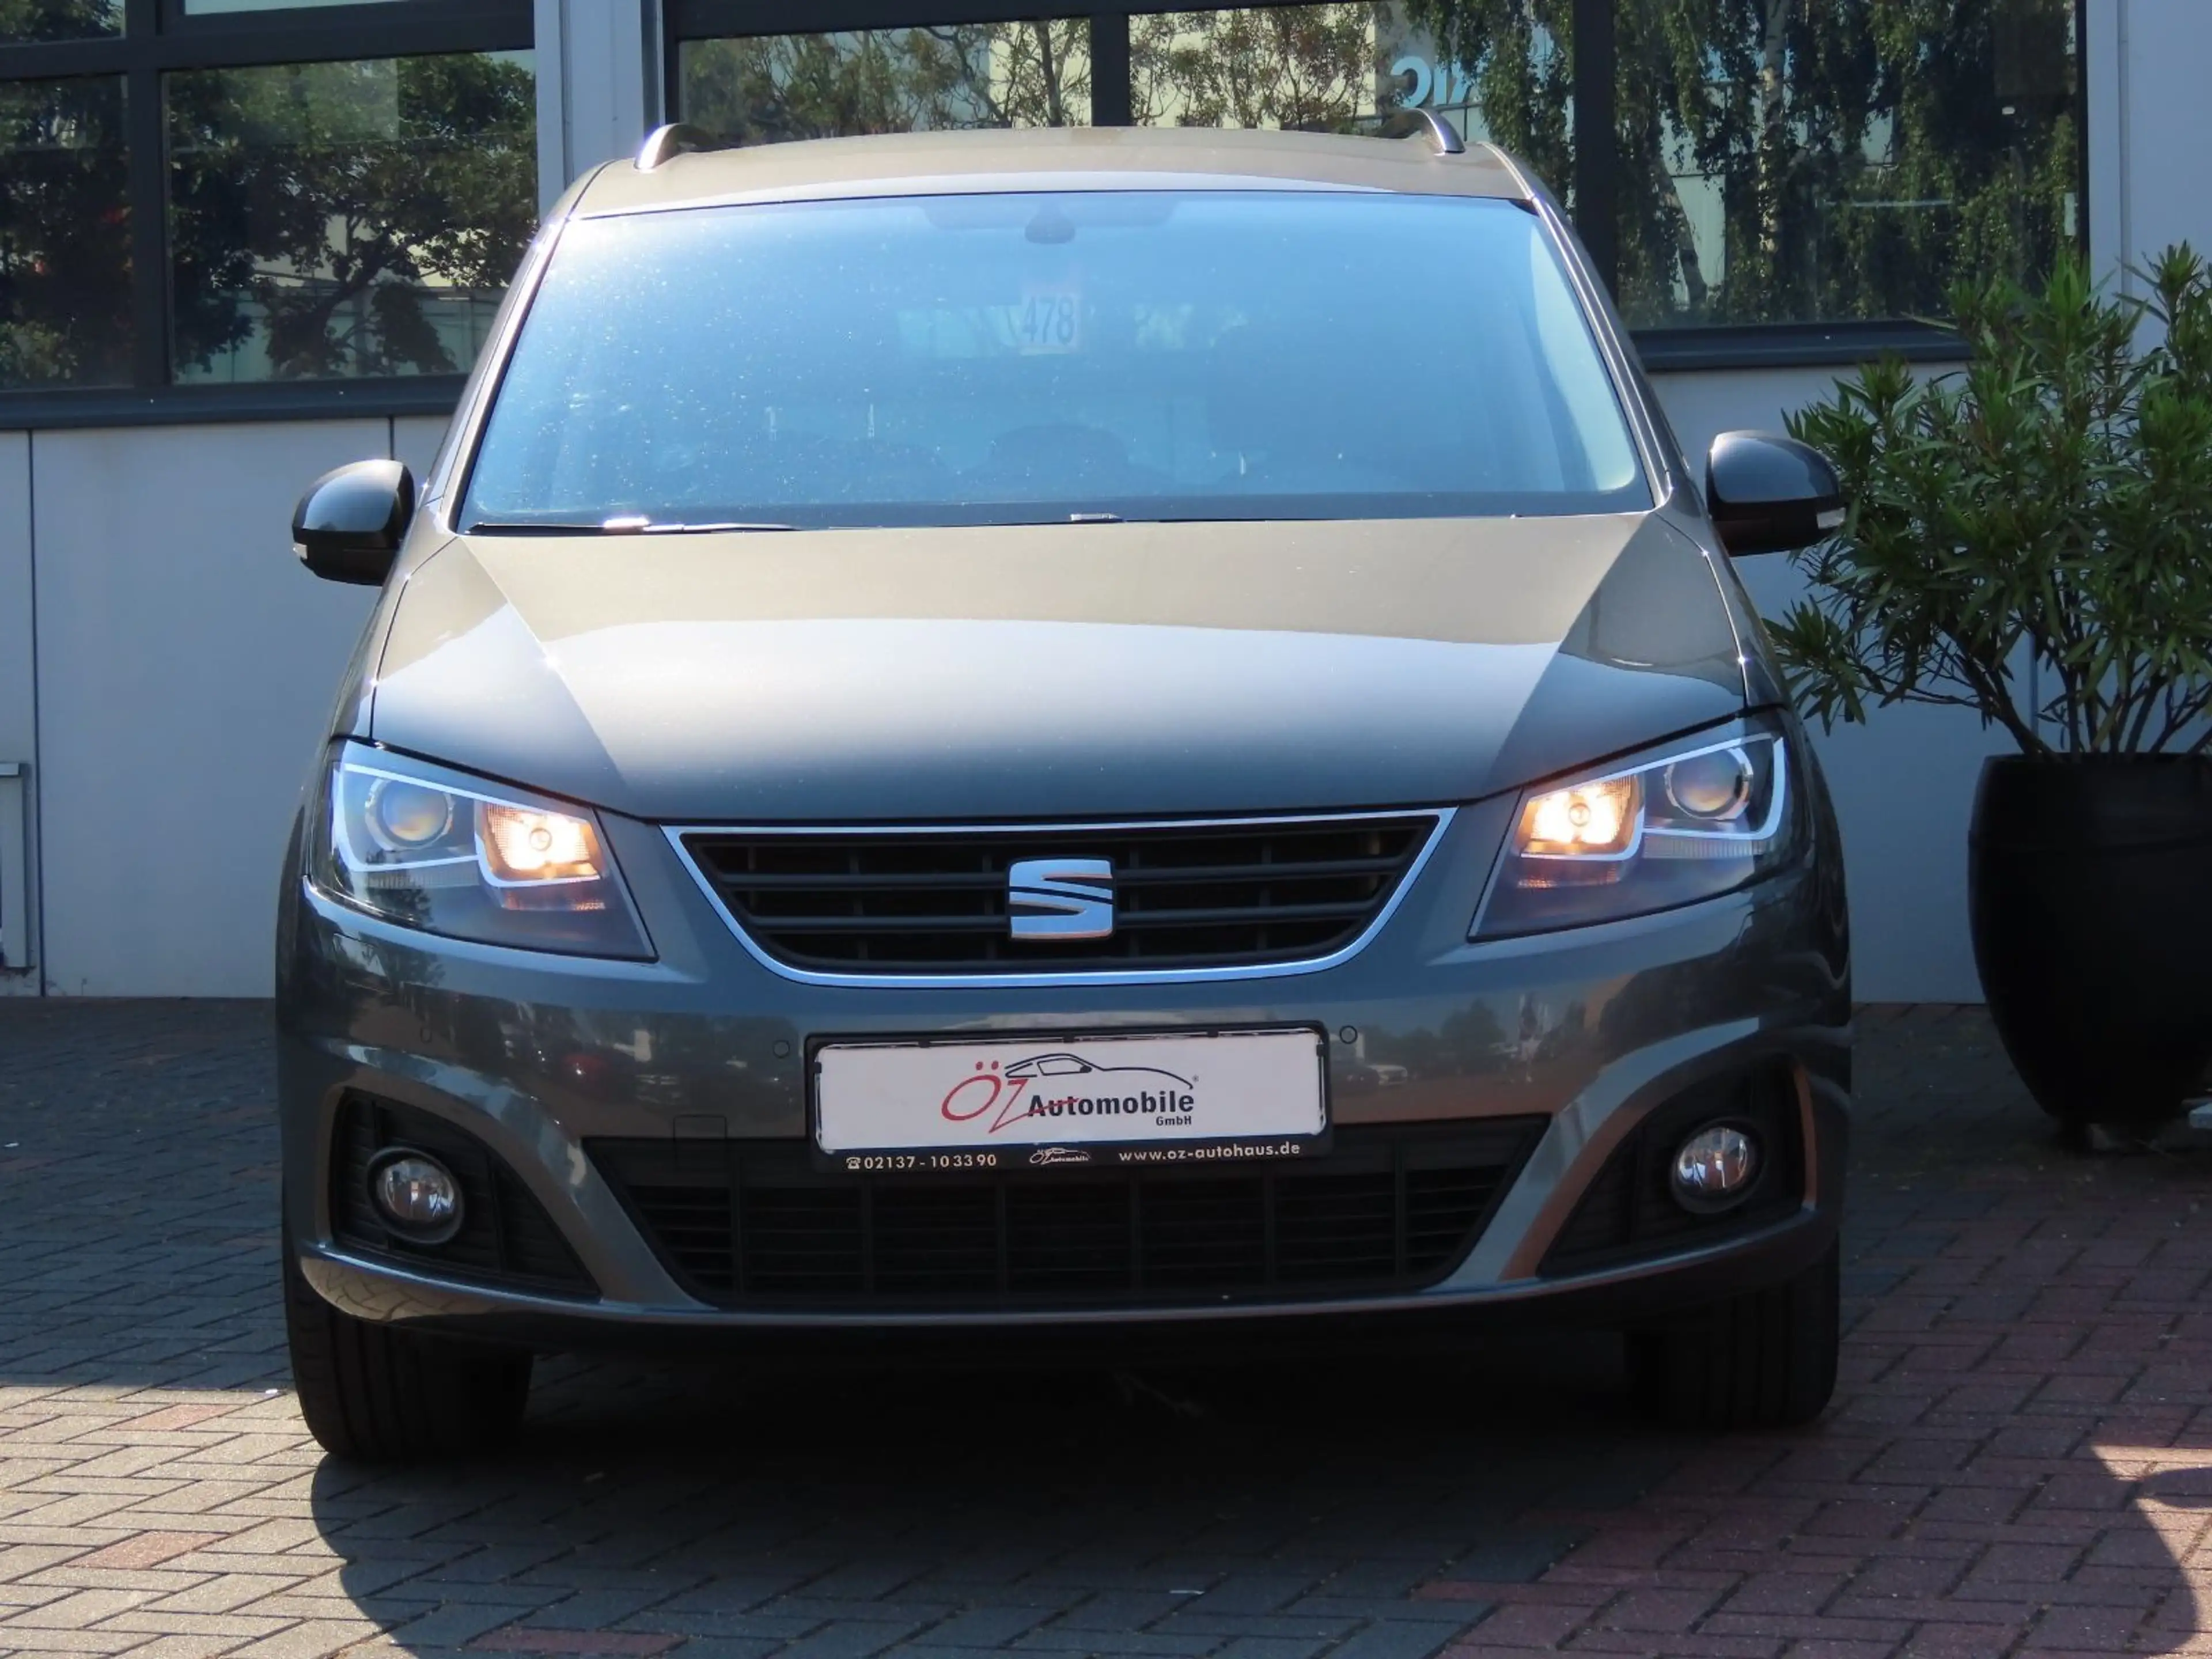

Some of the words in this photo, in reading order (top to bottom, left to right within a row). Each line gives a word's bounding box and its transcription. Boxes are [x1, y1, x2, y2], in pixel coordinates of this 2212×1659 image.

[1022, 296, 1075, 344] 478
[1028, 1090, 1194, 1117] Automobile
[1156, 1116, 1192, 1127] GmbH
[1119, 1141, 1301, 1161] www.oz-autohaus.de
